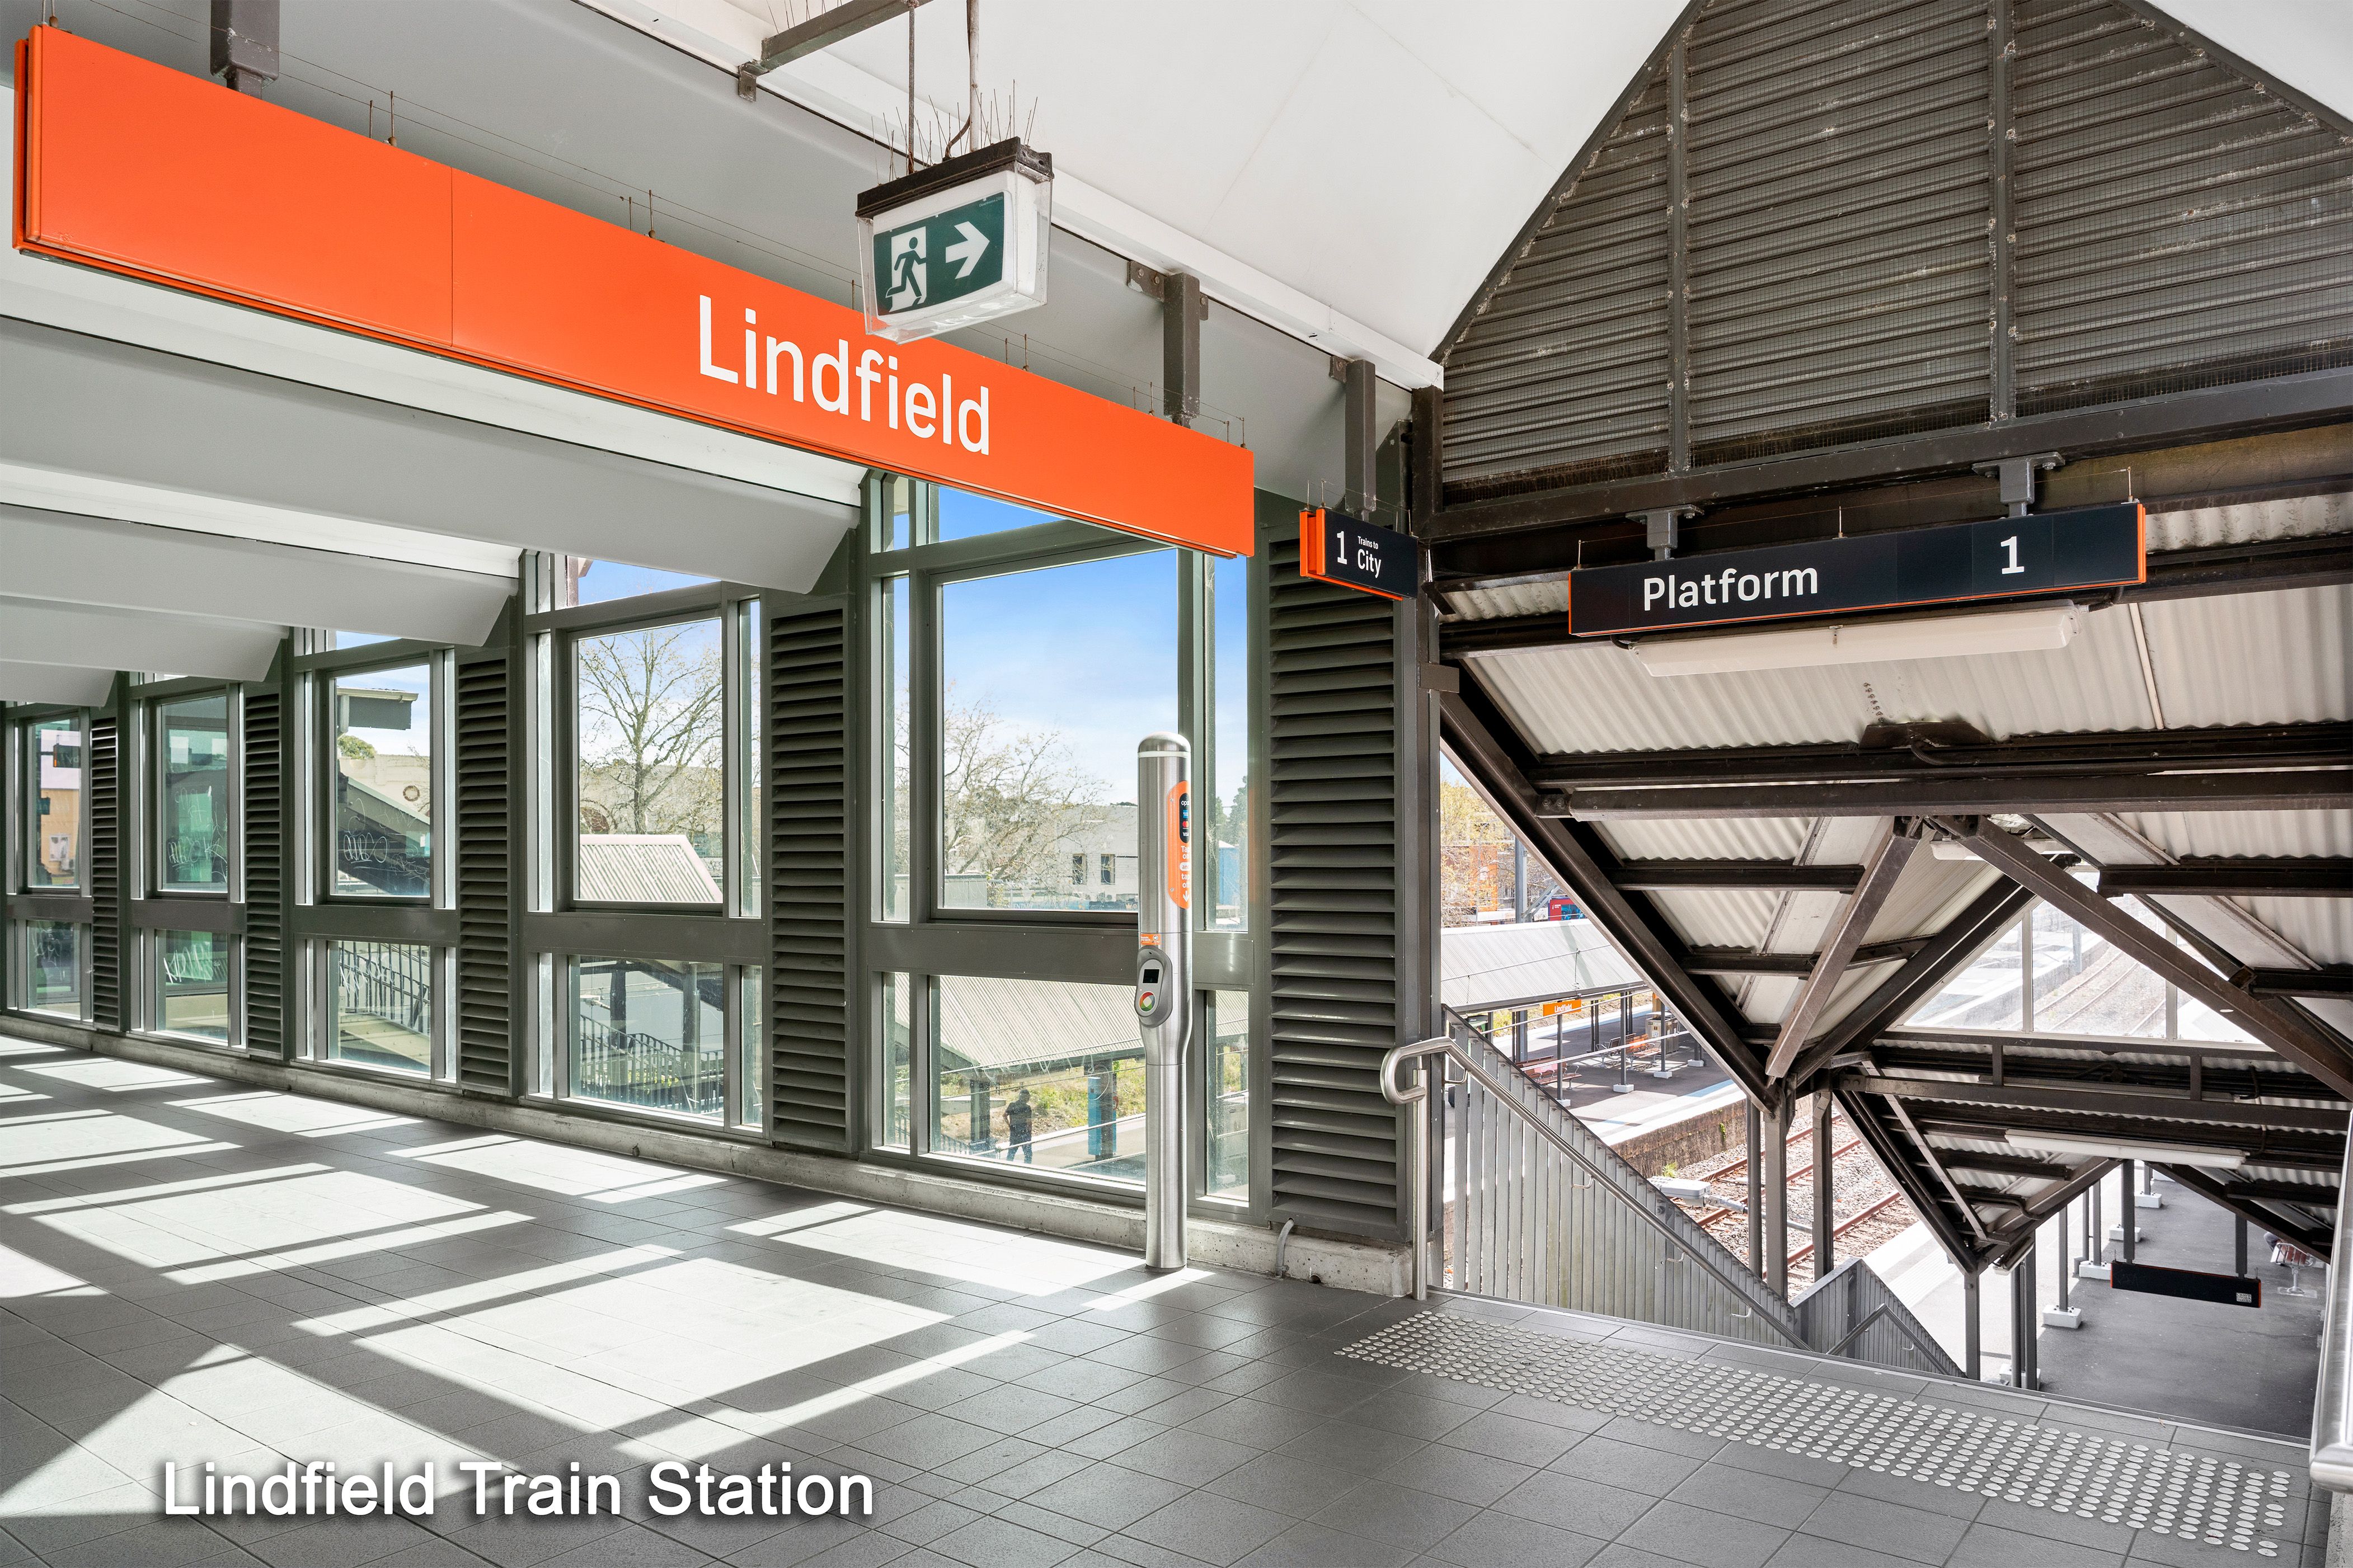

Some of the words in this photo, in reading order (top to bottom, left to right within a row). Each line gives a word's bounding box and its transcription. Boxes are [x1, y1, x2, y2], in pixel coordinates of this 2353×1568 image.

[699, 294, 989, 455] Lindfield
[1336, 530, 1347, 565] 1
[1358, 535, 1373, 548] Trains
[1373, 541, 1379, 550] to
[1358, 548, 1382, 579] City
[1644, 567, 1817, 611] Platform
[2000, 536, 2025, 575] 1
[1554, 1004, 1572, 1013] Lindfield
